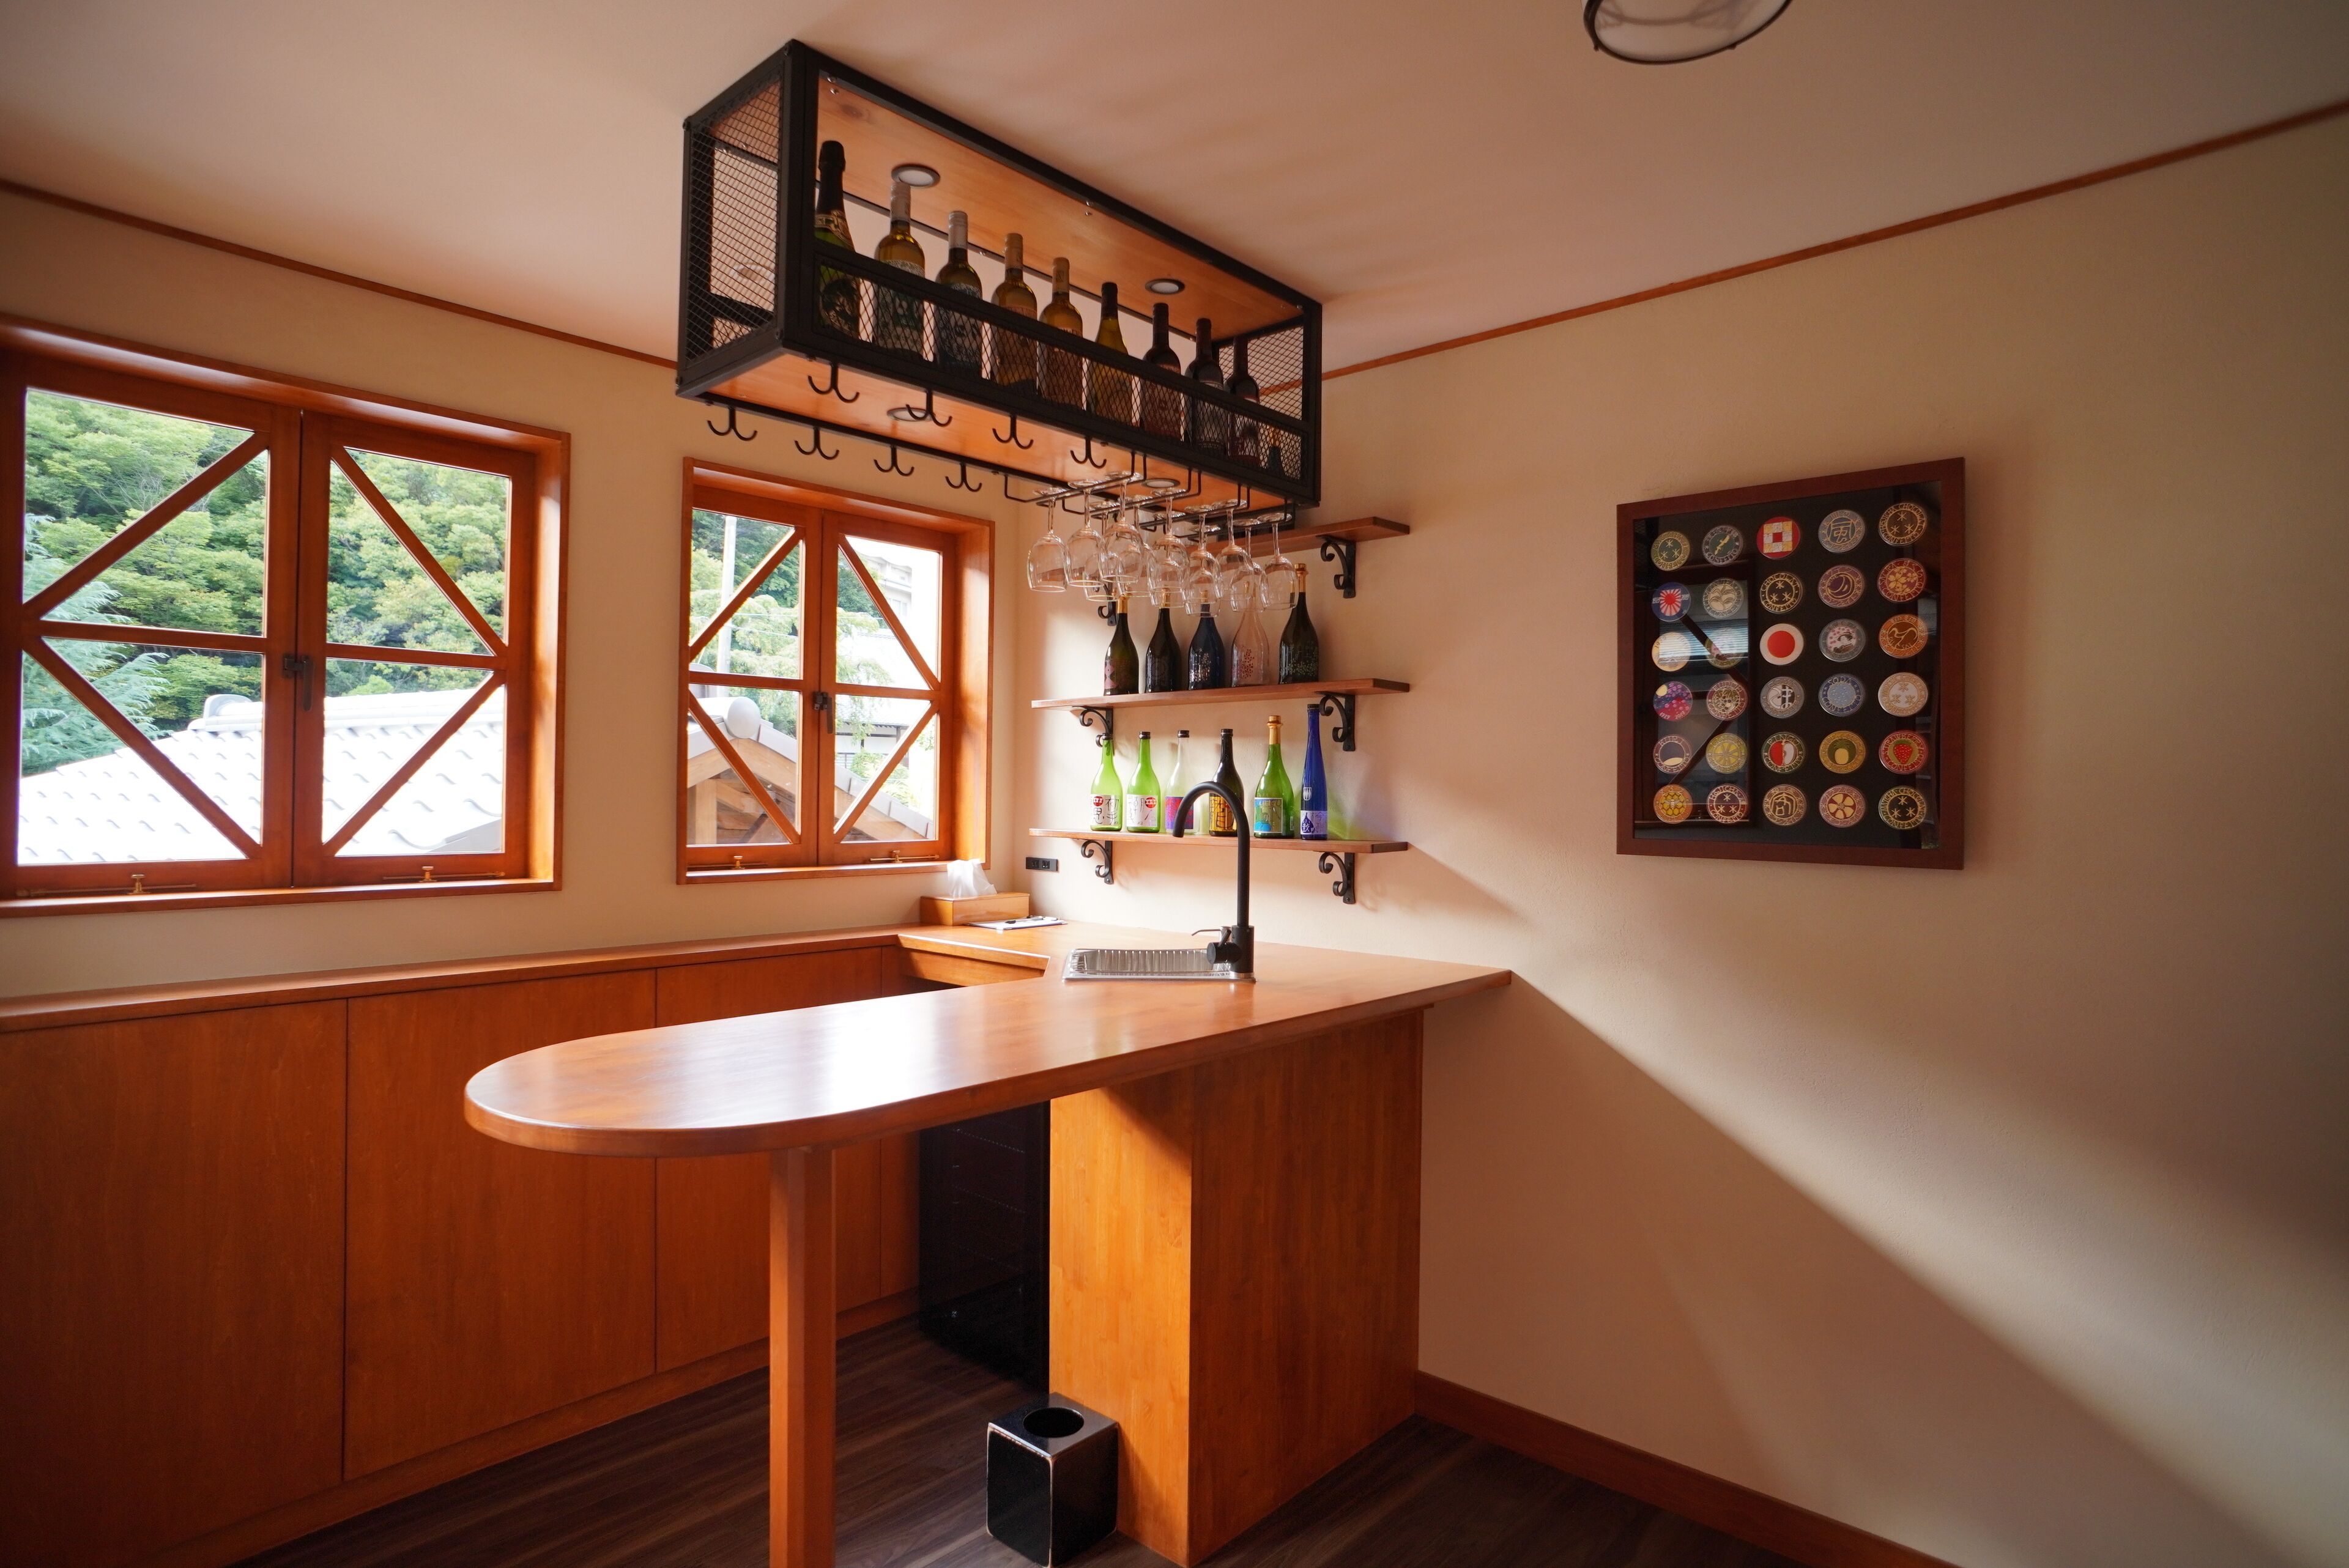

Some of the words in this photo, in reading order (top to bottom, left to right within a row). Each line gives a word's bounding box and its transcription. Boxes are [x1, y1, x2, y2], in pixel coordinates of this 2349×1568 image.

[1762, 574, 1799, 591] CHOCOLAT
[1767, 734, 1800, 745] RINGO
[1881, 732, 1925, 755] STRAWBERRY
[1881, 789, 1897, 812] MATCHA
[1898, 788, 1923, 812] CHOCOLAT
